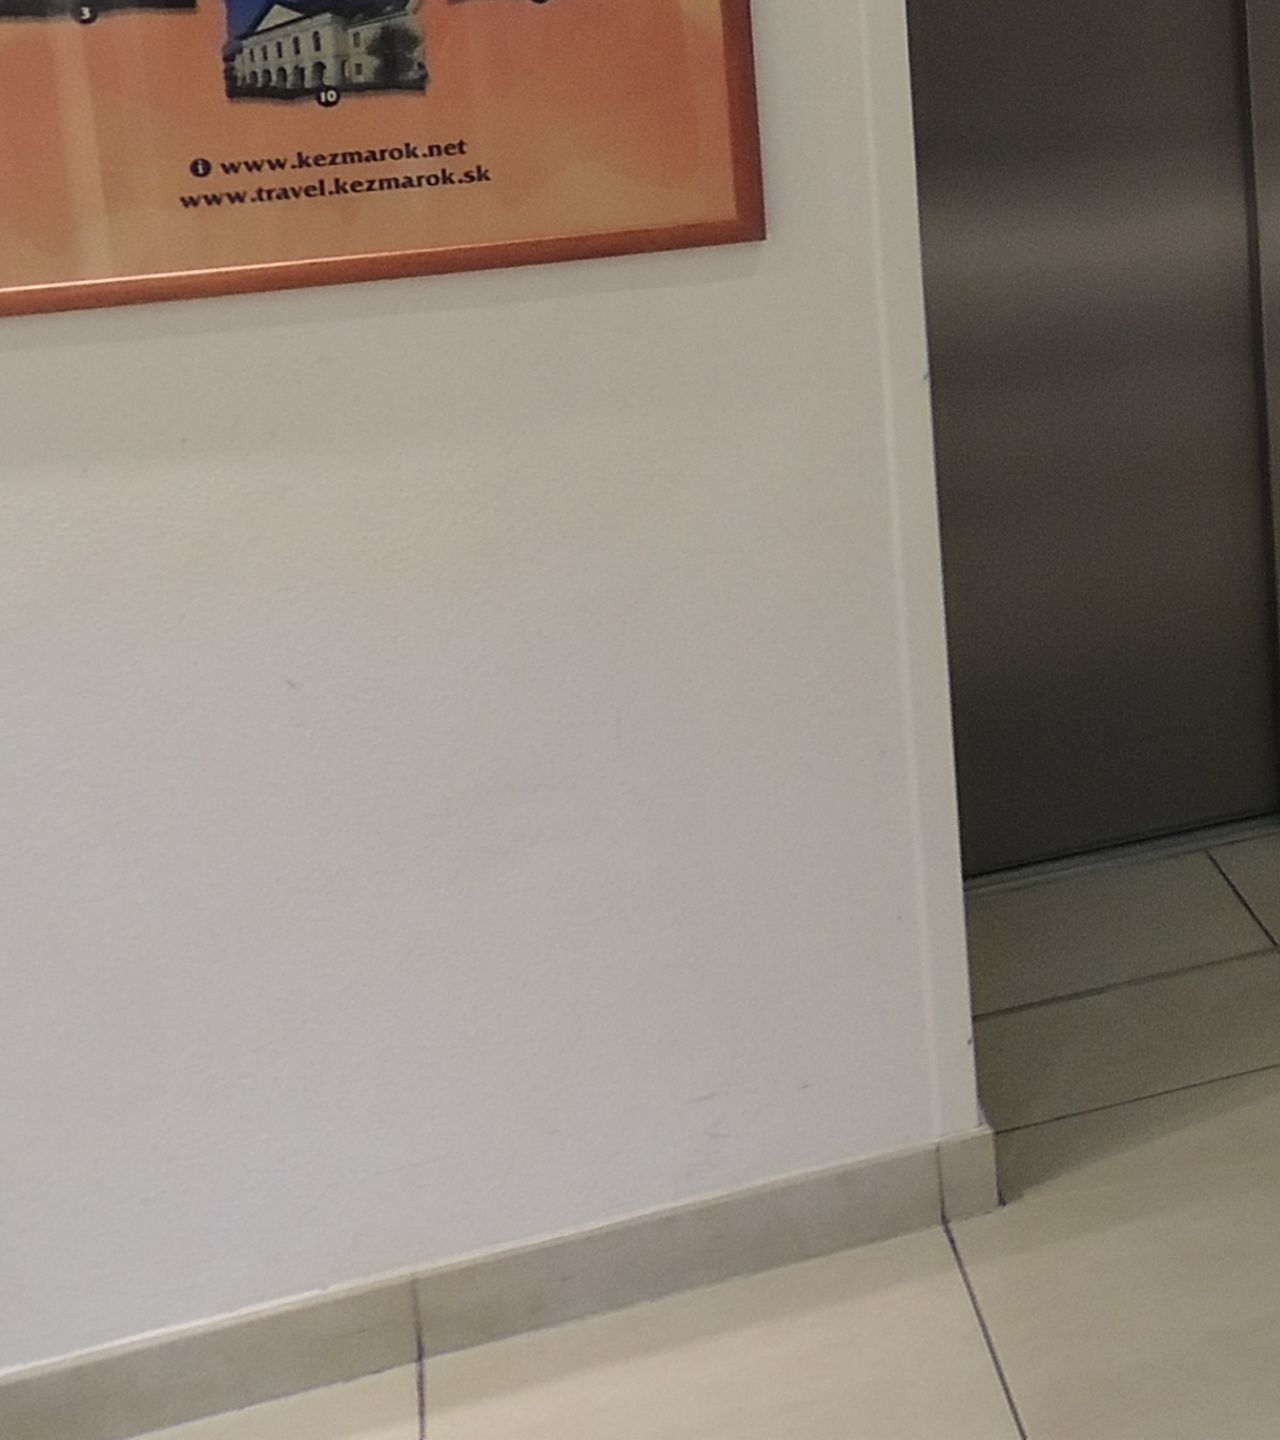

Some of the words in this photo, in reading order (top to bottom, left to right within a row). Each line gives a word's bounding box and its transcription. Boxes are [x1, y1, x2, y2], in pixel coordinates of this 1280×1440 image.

[79, 6, 91, 20] 3
[320, 91, 337, 103] 10
[220, 139, 467, 176] www.kezmarok.net
[180, 165, 492, 209] www.travel.kezmarok.sk
